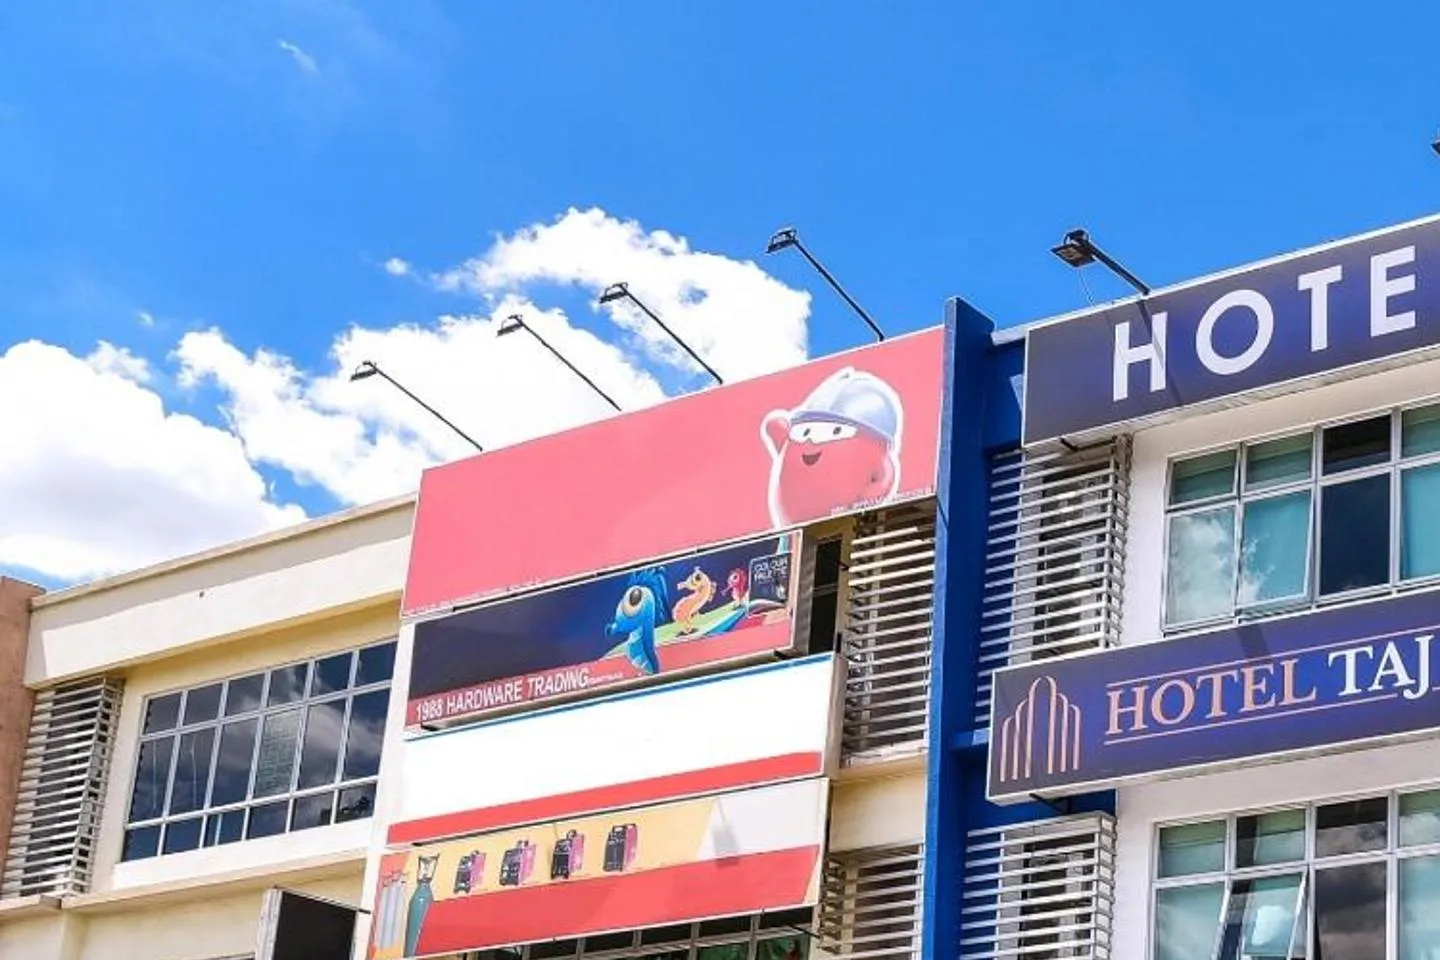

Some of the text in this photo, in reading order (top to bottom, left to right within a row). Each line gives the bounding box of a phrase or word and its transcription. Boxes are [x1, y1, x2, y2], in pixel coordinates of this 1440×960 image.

[446, 679, 524, 715] HARDWARE
[527, 667, 590, 698] TRADING
[1105, 659, 1317, 736] HOTEL
[1327, 634, 1434, 700] TAJ
